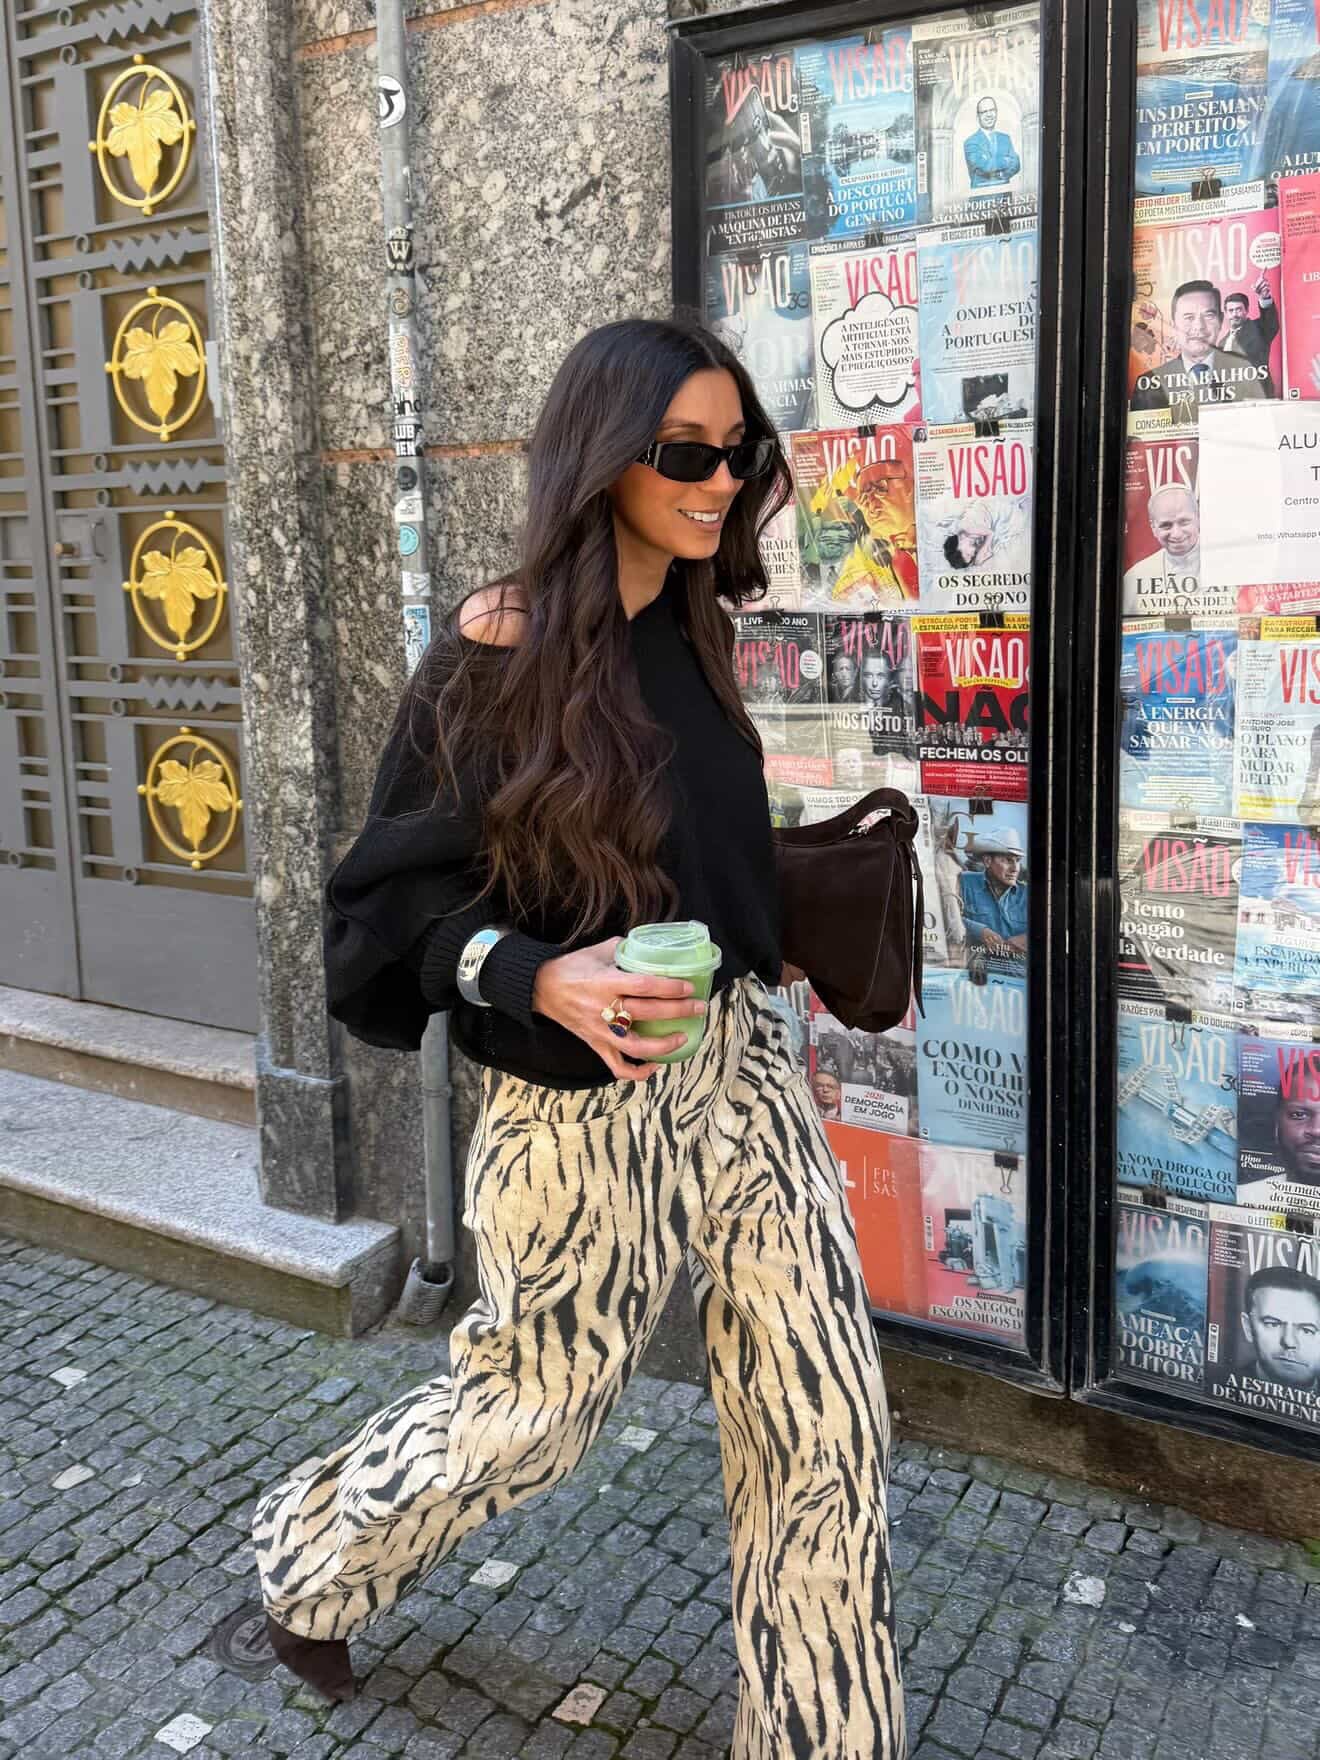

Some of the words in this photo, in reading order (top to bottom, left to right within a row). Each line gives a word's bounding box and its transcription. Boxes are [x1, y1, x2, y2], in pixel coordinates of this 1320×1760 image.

[1171, 104, 1194, 120] DE
[1151, 115, 1247, 138] PERFEITOS
[1136, 141, 1160, 156] EM
[1165, 131, 1262, 154] PORTUGAL
[827, 191, 834, 204] A
[837, 178, 914, 202] DESCOBERT
[828, 203, 848, 217] DO
[981, 205, 1032, 221] SESATOS
[768, 214, 782, 227] DE
[1155, 218, 1248, 287] VISÃO
[845, 248, 918, 312] VISÃO
[957, 305, 996, 321] ONDE
[841, 324, 848, 334] A
[841, 329, 889, 344] ARTIFICIAL
[844, 343, 850, 352] A
[841, 352, 863, 363] MAIS
[1137, 375, 1160, 390] OS
[1165, 364, 1269, 388] TRABALHOS
[1201, 383, 1236, 402] LUÍS
[1278, 432, 1320, 450] ALU
[948, 438, 1027, 499] VISÃO
[1145, 446, 1199, 498] VIS
[939, 575, 959, 588] OS
[1136, 573, 1198, 594] LEÃO
[956, 592, 979, 606] DO
[945, 632, 1024, 689] VISÃO
[1136, 634, 1226, 695] VISÃO
[833, 711, 858, 729] NOS
[1137, 704, 1147, 720] A
[1152, 706, 1225, 720] ENERGIA
[1129, 735, 1232, 749] SALVAR-NOS
[920, 747, 978, 761] FECHEM
[981, 750, 1001, 762] OS
[1240, 759, 1295, 773] MUDAR
[835, 795, 861, 803] TODO
[1143, 838, 1231, 897] VISÃO
[1284, 831, 1320, 888] VI
[1134, 900, 1185, 919] lento
[1120, 920, 1185, 940] pagão
[1142, 940, 1225, 965] Verdade
[923, 1039, 1002, 1069] COMO
[945, 1079, 959, 1095] O
[845, 1095, 905, 1114] DEMOCRACIA
[853, 1105, 867, 1115] EM
[869, 1108, 895, 1120] JOGO
[958, 1098, 1020, 1119] DINHEIRO
[1128, 1152, 1163, 1169] NOVA
[1166, 1159, 1214, 1180] DROGA
[955, 1296, 971, 1308] OS
[932, 1306, 1010, 1329] ESCONDIDOS
[1226, 1373, 1237, 1388] A
[1212, 1383, 1236, 1402] DE
